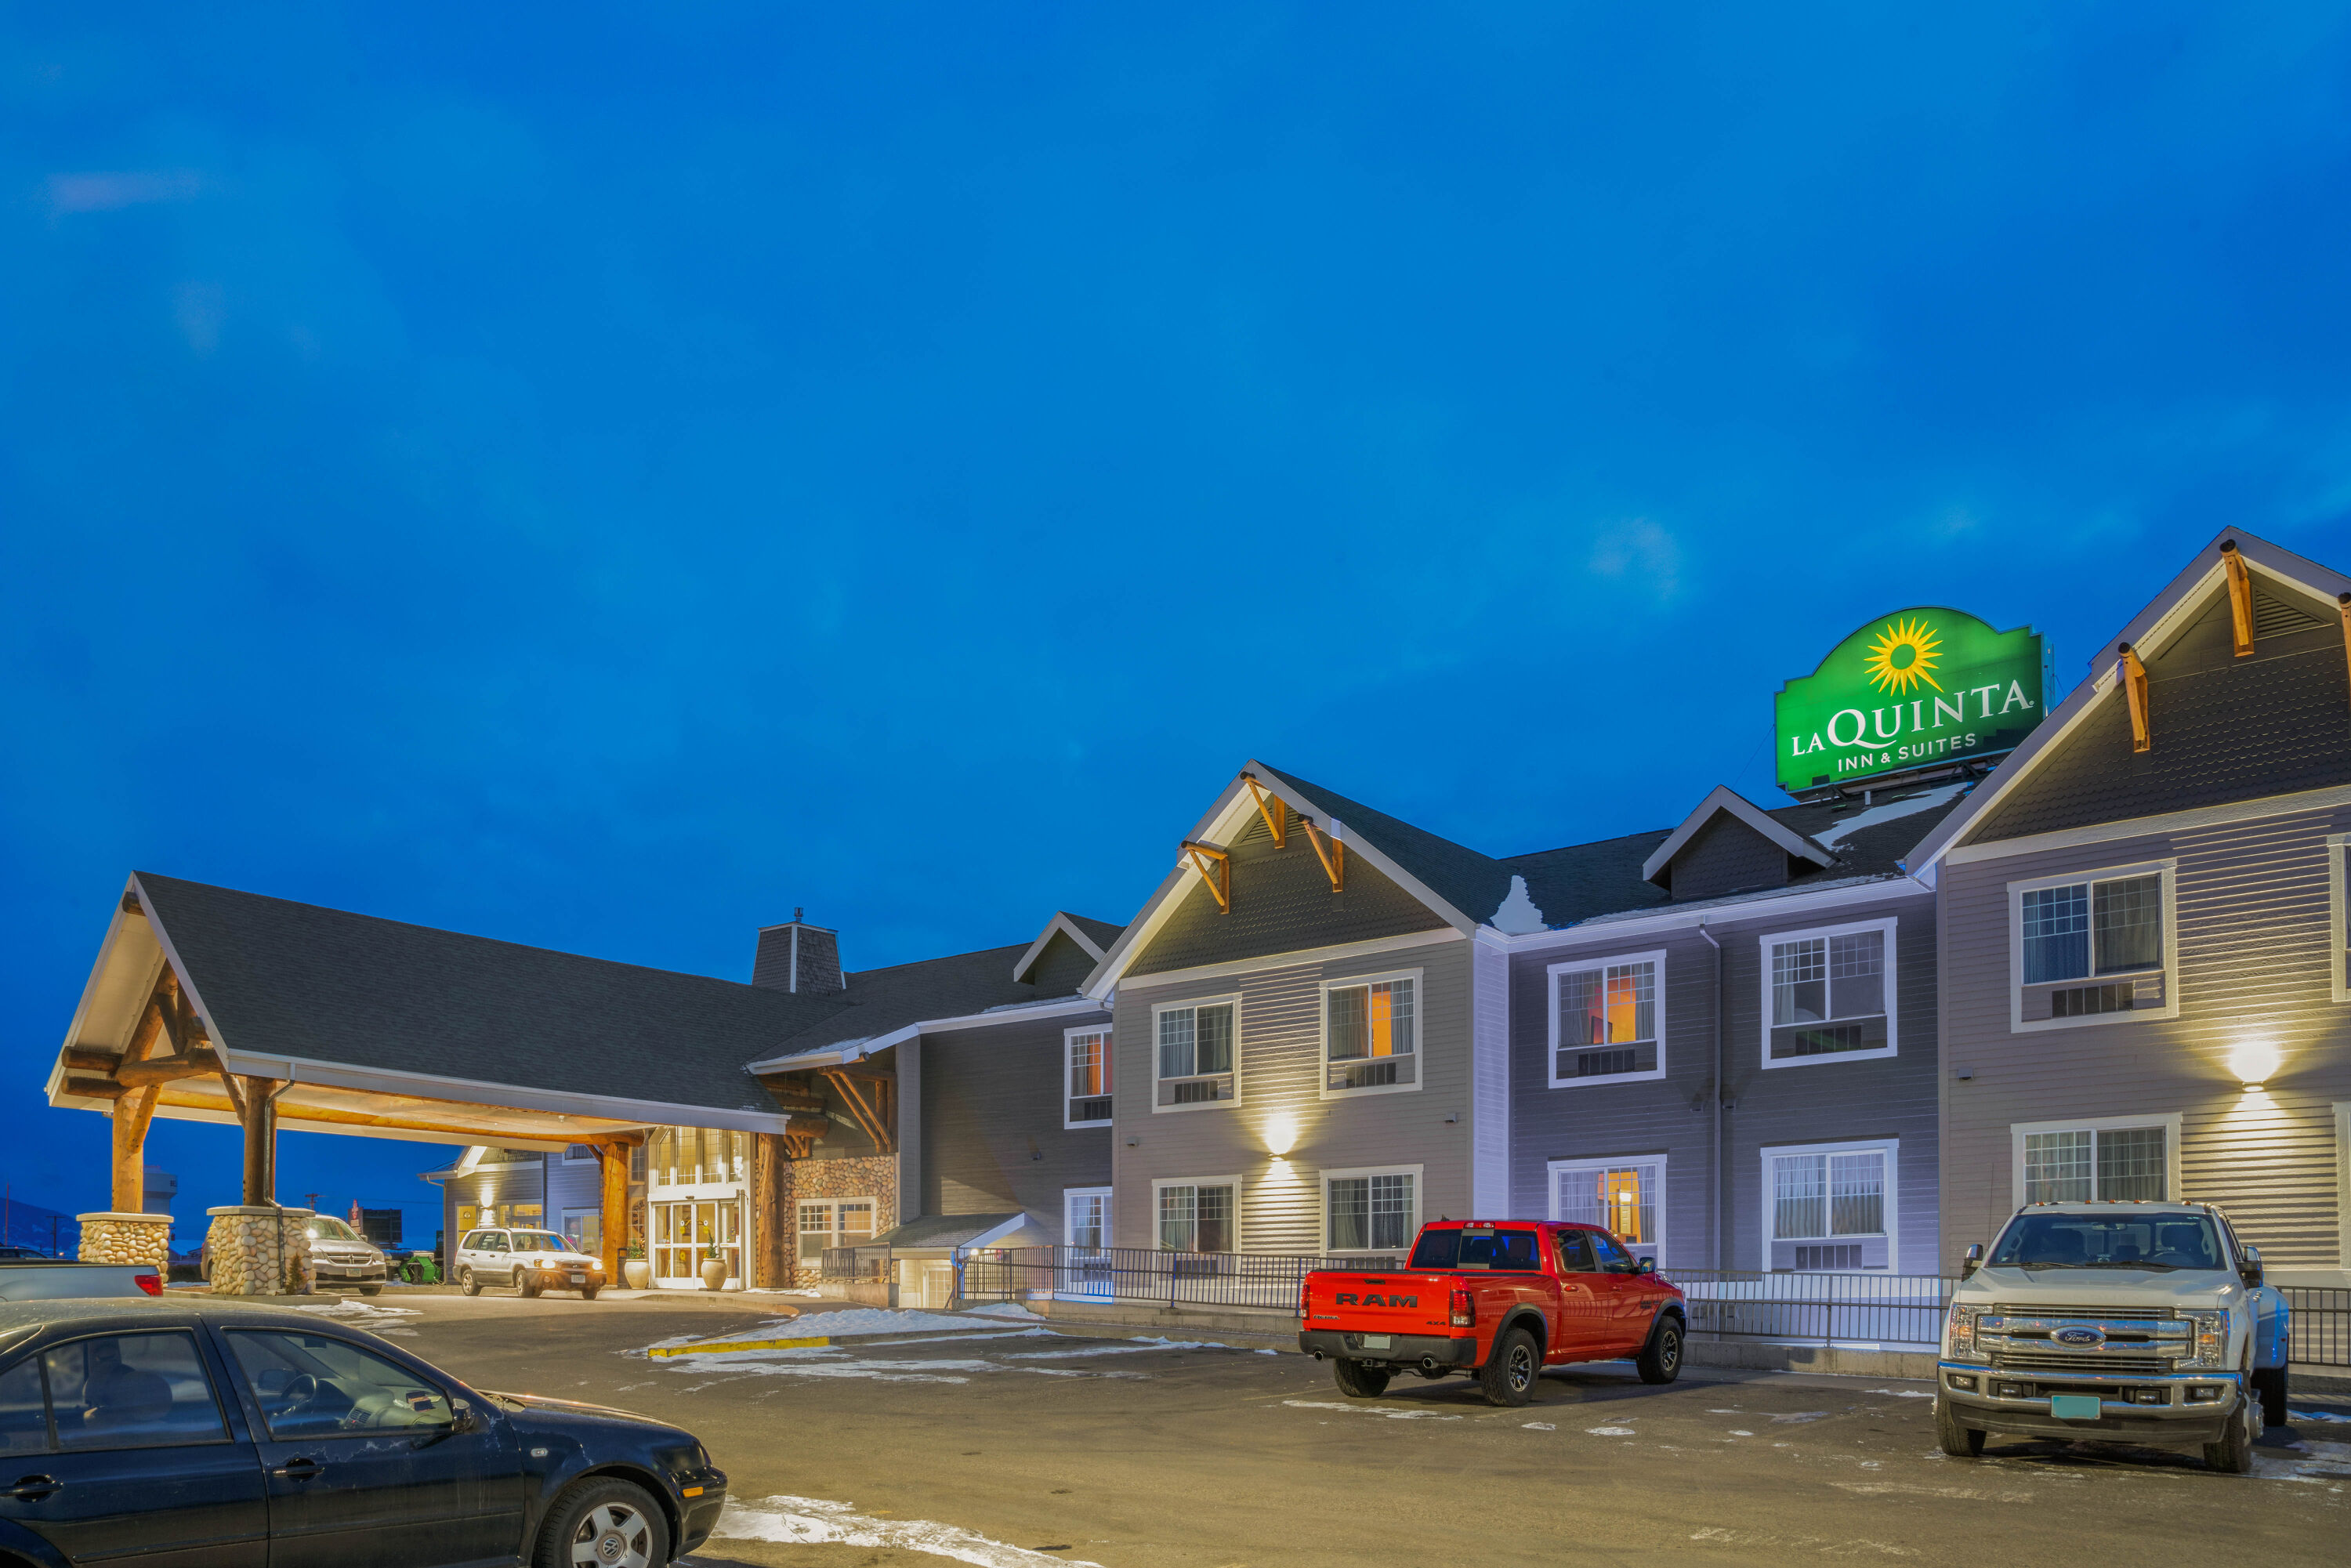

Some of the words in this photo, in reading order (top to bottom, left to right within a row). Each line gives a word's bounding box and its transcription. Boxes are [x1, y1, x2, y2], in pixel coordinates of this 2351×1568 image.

[1791, 732, 1827, 757] LA
[1838, 753, 1874, 773] INN
[1880, 752, 1891, 764] &
[1898, 733, 1976, 760] SUITES
[1335, 1293, 1418, 1308] RAM
[2064, 1331, 2091, 1342] Ford
